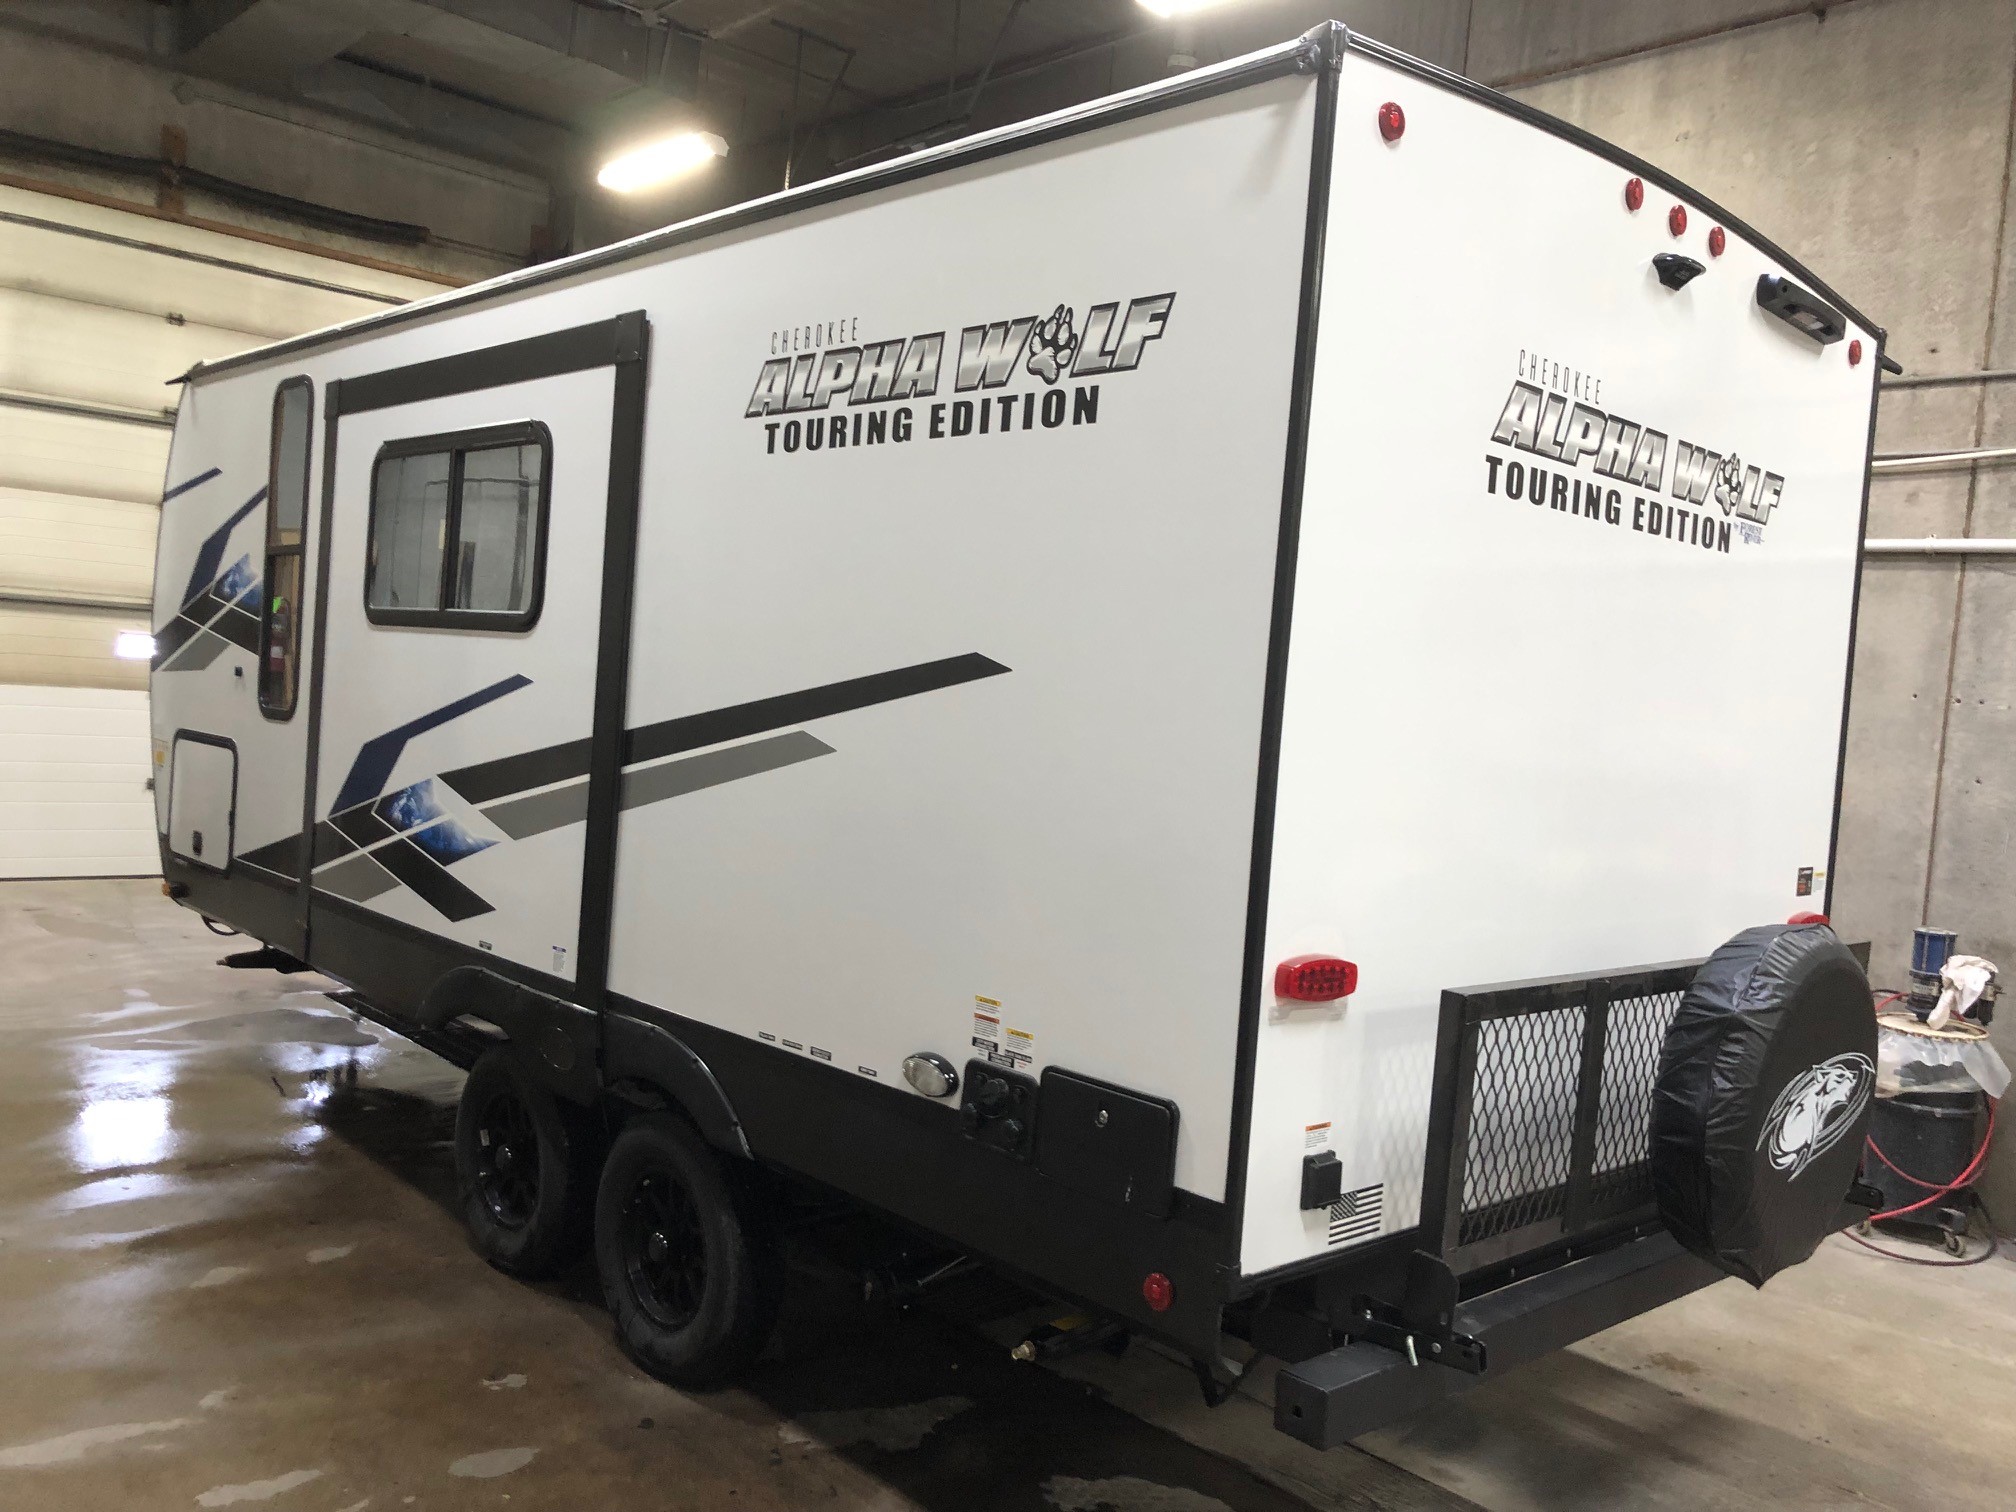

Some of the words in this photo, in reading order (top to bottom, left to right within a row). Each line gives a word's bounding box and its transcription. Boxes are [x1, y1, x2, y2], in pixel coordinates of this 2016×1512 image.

[744, 331, 946, 419] ALPHA
[771, 317, 859, 355] CHEROKEE
[1518, 349, 1602, 404] CHEROKEE
[765, 407, 912, 455] TOURING
[929, 385, 1099, 440] EDITION
[1491, 379, 1668, 492] ALPHA
[1486, 454, 1622, 526] TOURING
[1632, 496, 1731, 553] EDITION
